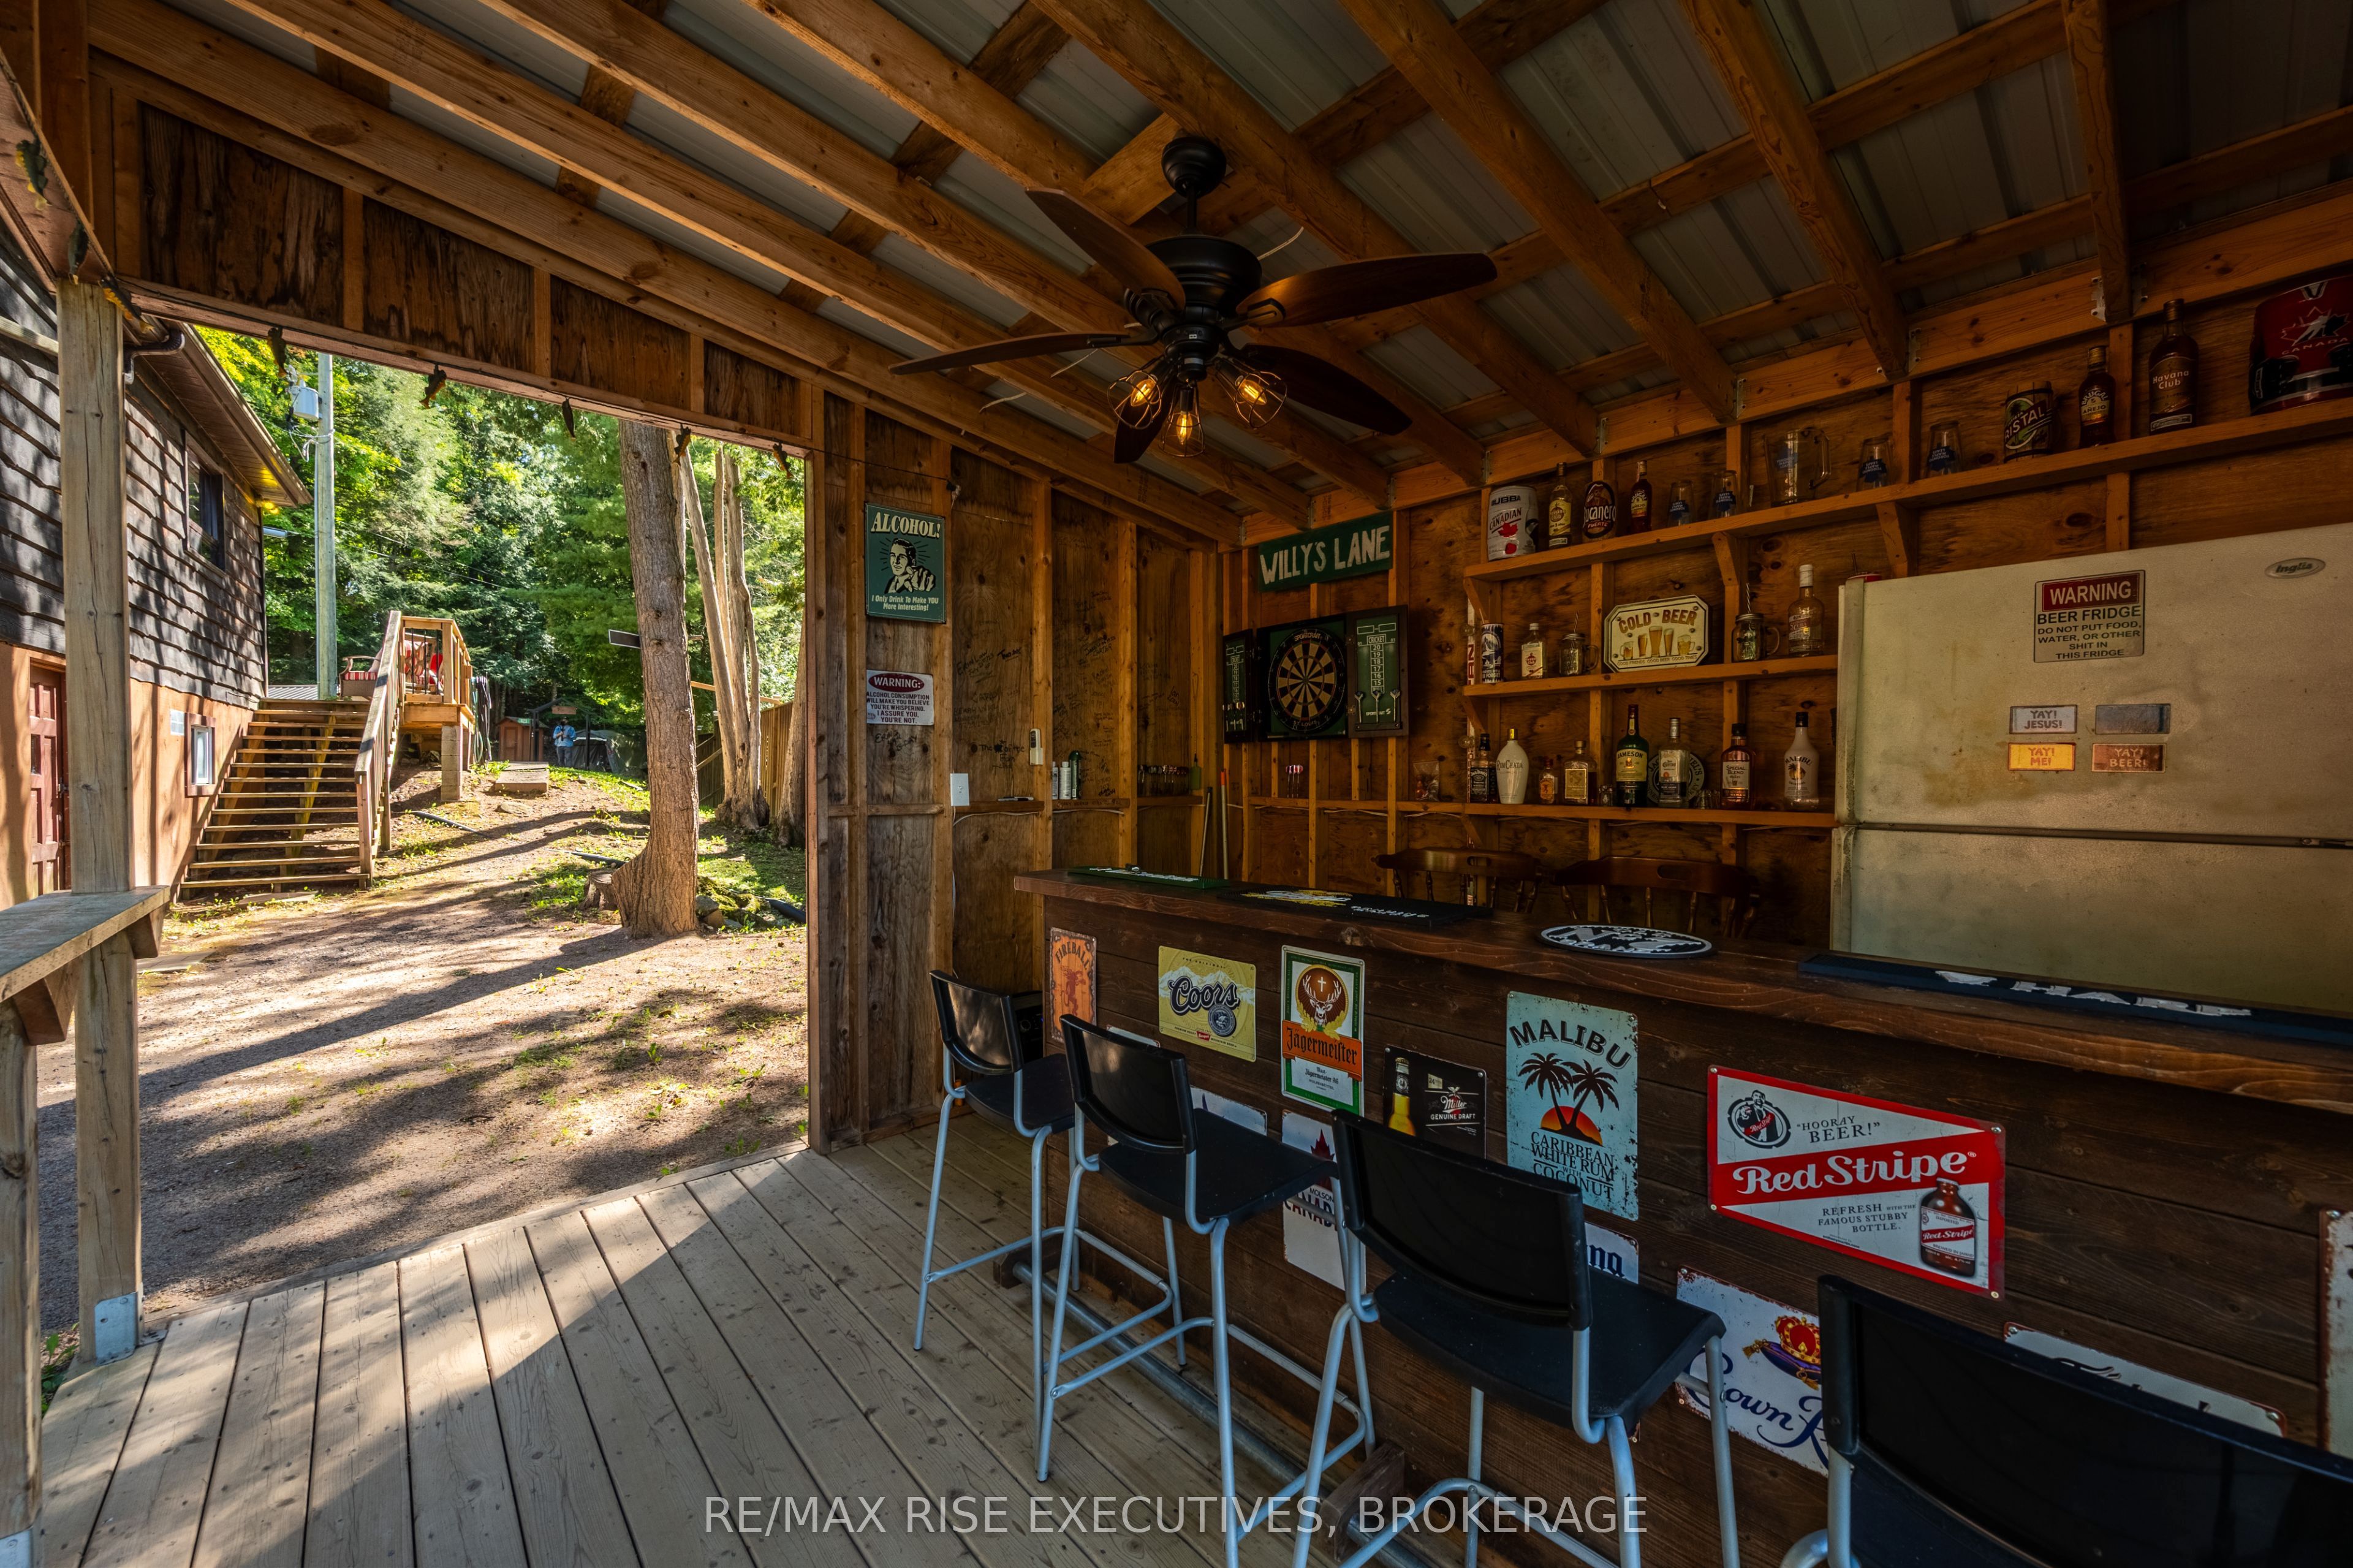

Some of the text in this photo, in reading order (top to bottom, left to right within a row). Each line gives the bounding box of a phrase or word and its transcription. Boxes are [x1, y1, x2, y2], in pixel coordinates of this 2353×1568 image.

[2281, 337, 2349, 355] CANADA
[2153, 370, 2189, 384] Havana
[2159, 379, 2181, 389] Club
[2082, 390, 2108, 405] BRUGAL
[2083, 405, 2106, 414] AÑEJO
[871, 512, 941, 539] ALCOHOL!
[1490, 507, 1521, 530] CANADIAN
[1260, 525, 1390, 585] WILLY'S LANE
[2276, 562, 2313, 574] Inglis
[875, 595, 888, 604] Only
[2050, 581, 2131, 605] WARNING
[1618, 609, 1697, 634] COLD BEER
[2037, 606, 2141, 624] BEER FRIDGE
[1368, 635, 1385, 644] CRICKET
[873, 676, 921, 688] WARNING:
[2030, 711, 2057, 719] YAY!
[2025, 720, 2062, 729] JESUS!
[1785, 756, 1812, 765] MALIBU
[2030, 757, 2052, 765] ME!
[1056, 941, 1089, 971] FIREBALL
[1169, 975, 1240, 1016] Coors
[1287, 1026, 1358, 1066] Jägermeister
[1509, 1019, 1632, 1070] MALIBU
[1305, 1068, 1332, 1082] Jägermeister
[1441, 1096, 1468, 1111] Miller
[1750, 1121, 1762, 1133] Red
[1531, 1132, 1614, 1168] CARIBBEAN
[1531, 1143, 1614, 1182] WHITE RUM
[1563, 1167, 1581, 1177] WITH
[1732, 1150, 1968, 1195] Red Stripe
[1534, 1163, 1613, 1199] COCONUT
[1309, 1187, 1334, 1202] MOLSON
[1823, 1203, 1882, 1216] REFRESH
[1818, 1212, 1908, 1225] FAMOUS STUBBY
[1936, 1216, 1959, 1225] IMPORTED
[1852, 1223, 1901, 1233] BOTTLE.
[1923, 1229, 1973, 1240] Red Stripe
[1933, 1244, 1952, 1254] BREWED
[1586, 1244, 1624, 1278] na
[1685, 1346, 1794, 1431] Cown
